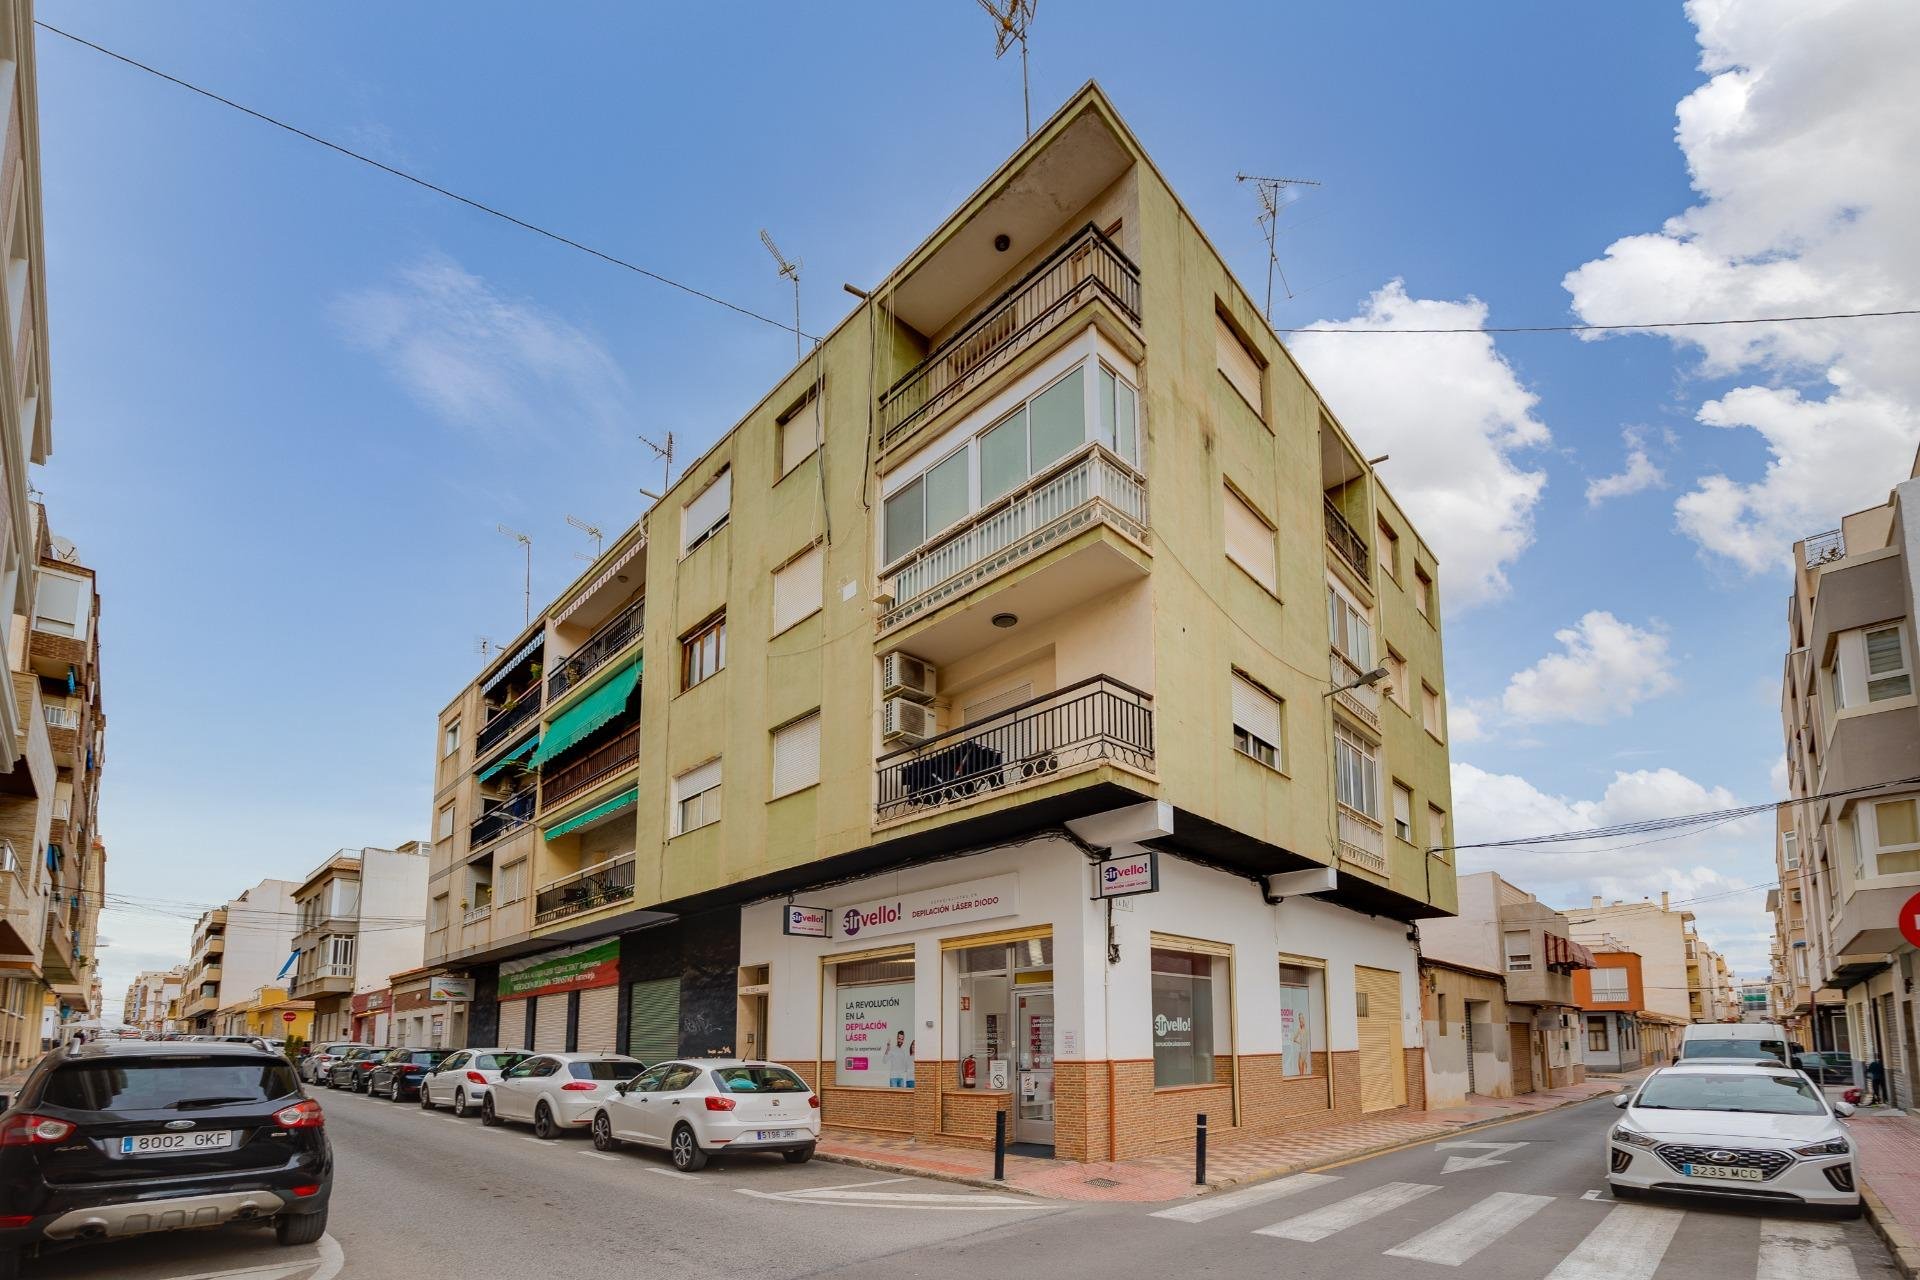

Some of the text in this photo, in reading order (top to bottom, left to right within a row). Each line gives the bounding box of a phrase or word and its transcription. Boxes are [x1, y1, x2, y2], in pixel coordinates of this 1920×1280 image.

[912, 897, 999, 918] DEPILACIÓN LÁSER DIODO
[855, 997, 900, 1009] REVOLUCIÓN
[845, 1012, 854, 1020] EN
[845, 1021, 887, 1031] DEPILACIÓN
[845, 1033, 867, 1042] LÁSER
[139, 1133, 227, 1150] 8002 GKF
[1693, 1166, 1758, 1179] 5235 MCC
